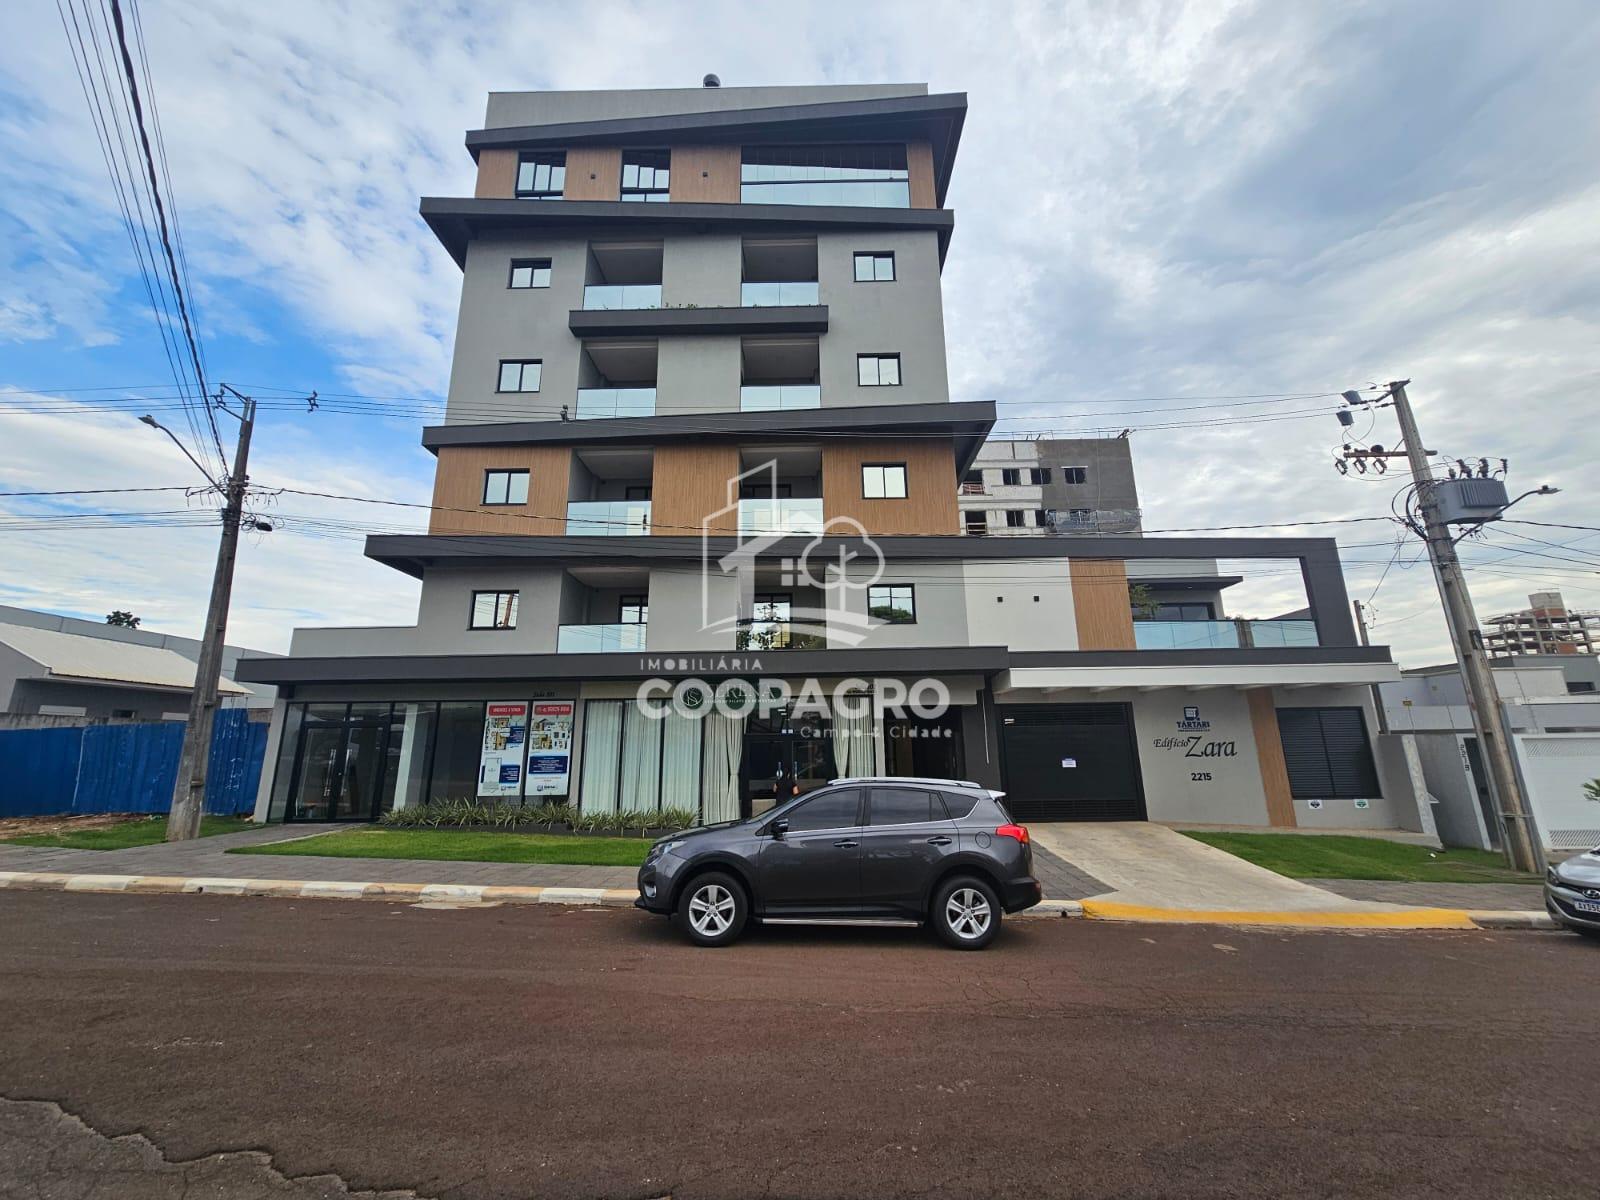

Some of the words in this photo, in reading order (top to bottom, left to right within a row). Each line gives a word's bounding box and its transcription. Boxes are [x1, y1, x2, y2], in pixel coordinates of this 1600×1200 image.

[1153, 737, 1188, 751] Edifício
[1185, 735, 1238, 758] Zara
[1190, 772, 1212, 781] 2215
